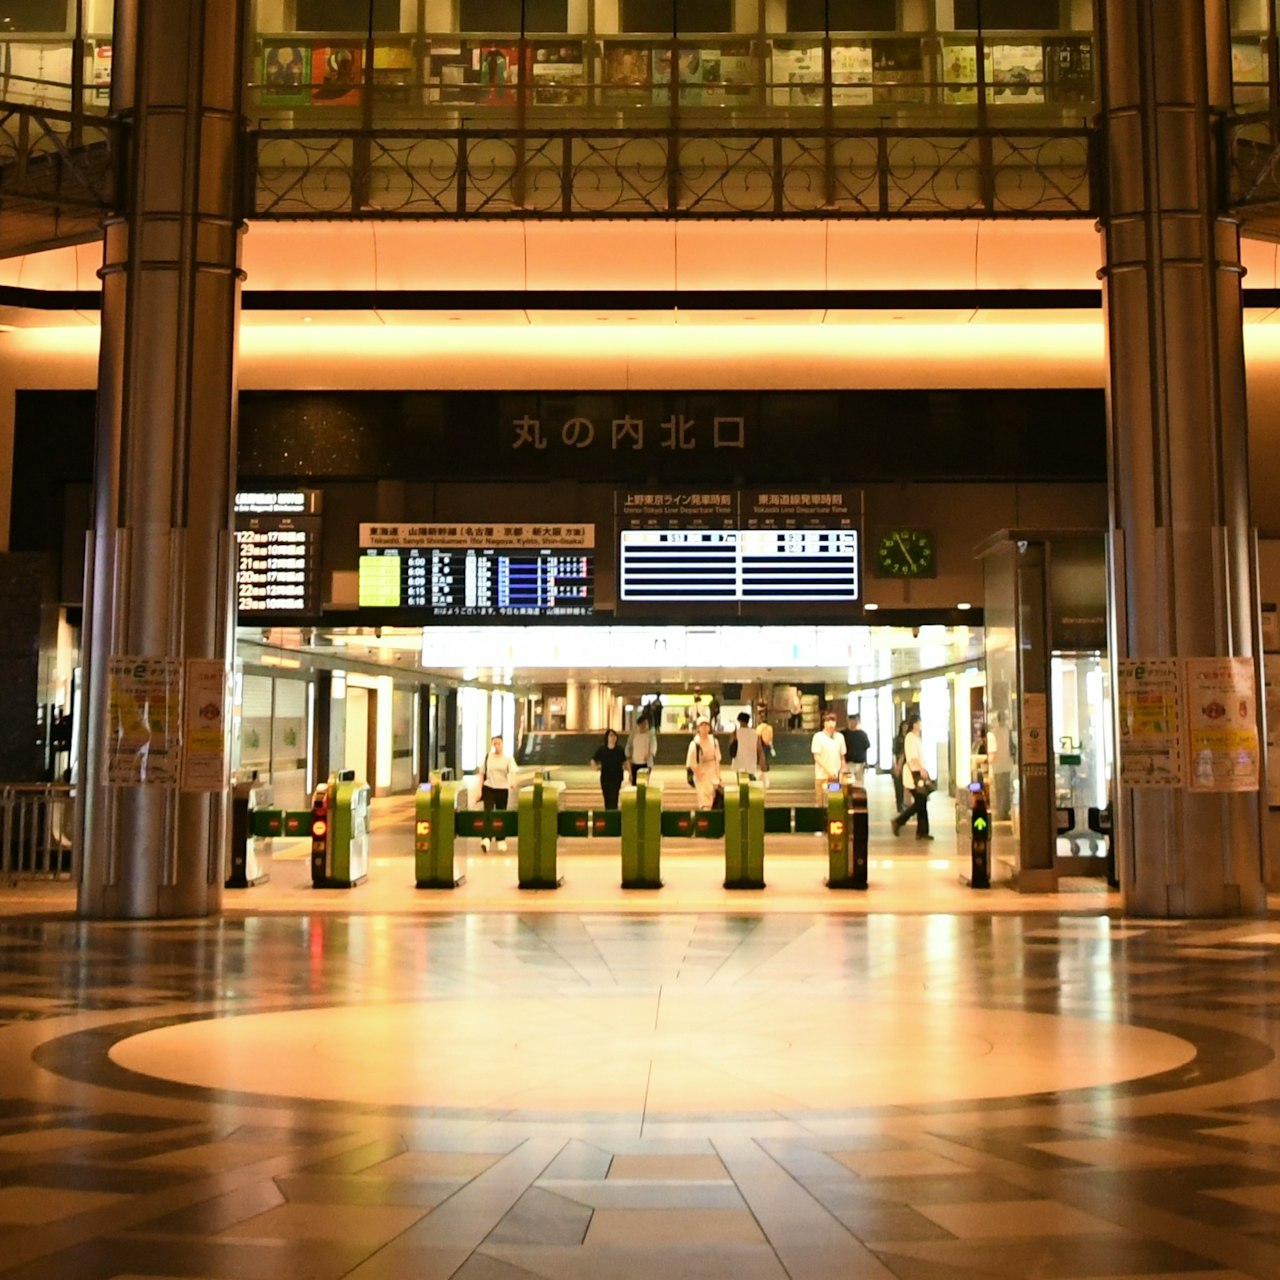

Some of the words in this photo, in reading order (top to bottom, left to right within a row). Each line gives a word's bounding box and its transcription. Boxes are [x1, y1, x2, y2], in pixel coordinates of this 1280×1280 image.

[511, 414, 746, 450] 丸の内北口
